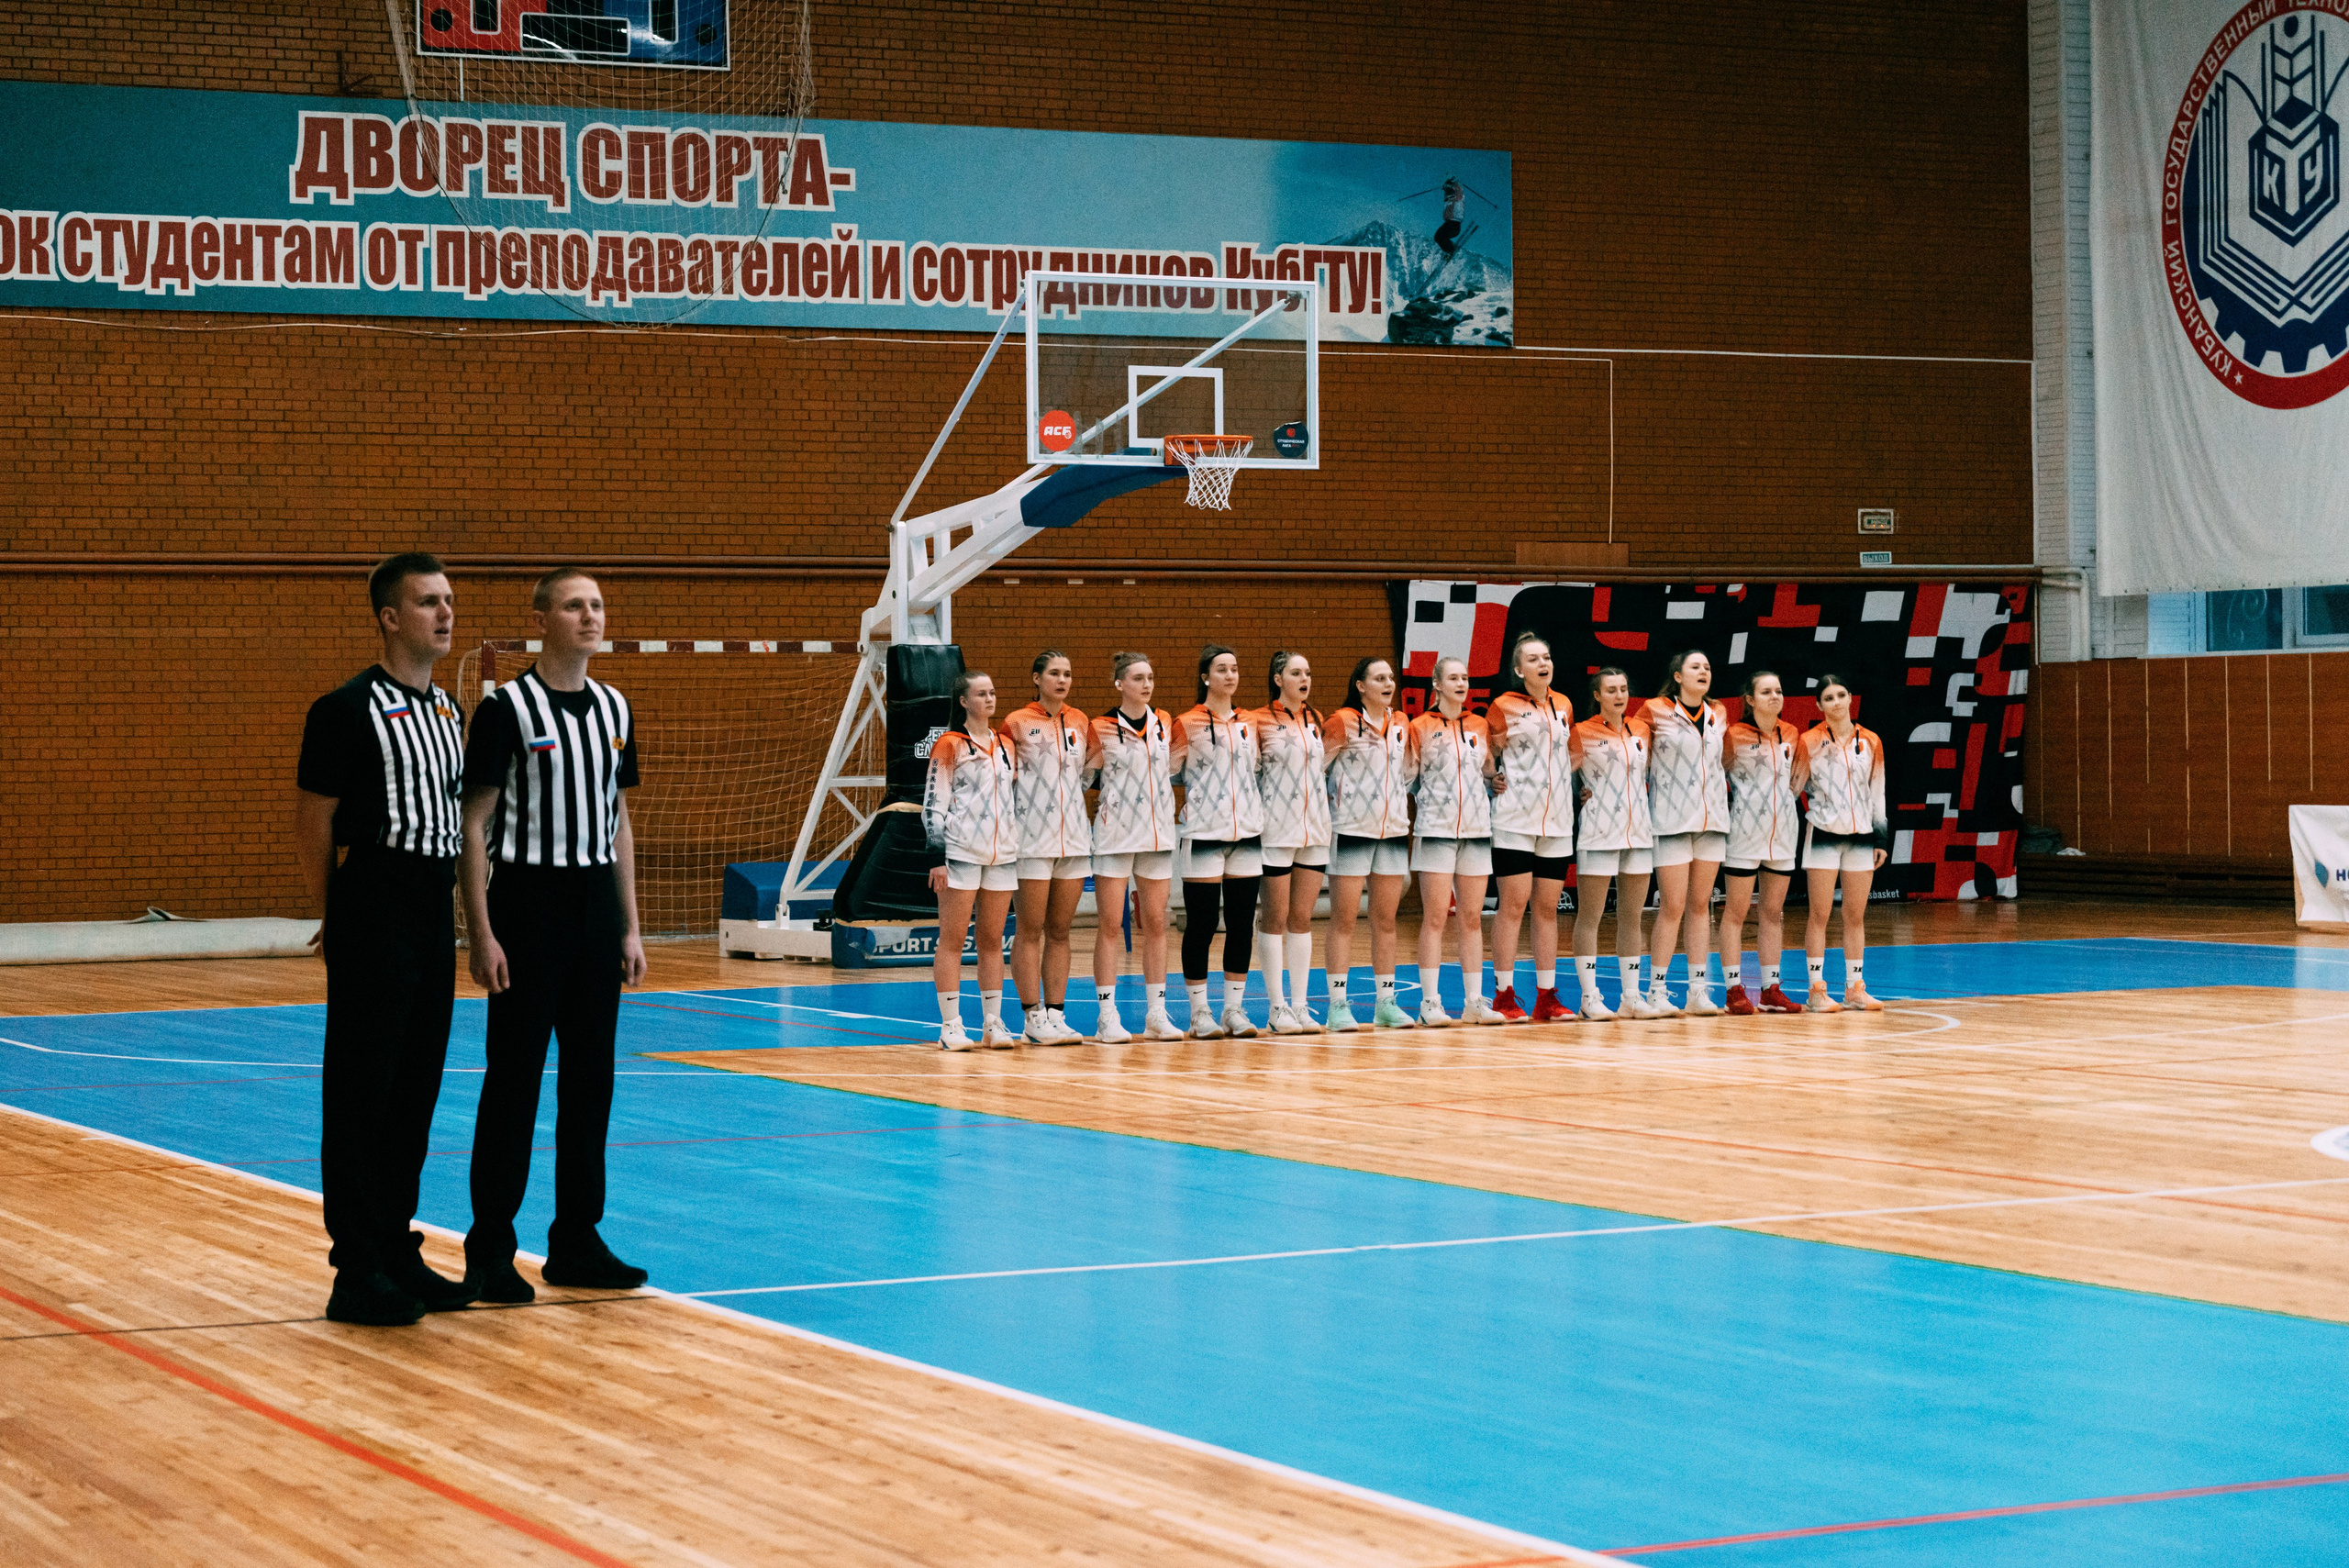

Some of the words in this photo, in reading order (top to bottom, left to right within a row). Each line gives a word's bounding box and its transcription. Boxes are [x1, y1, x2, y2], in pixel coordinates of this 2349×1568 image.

[2164, 0, 2277, 226] ГОСУДАРСТВЕННЫЙ
[295, 116, 566, 209] ДВОРЕЦ
[61, 214, 350, 291] студентам
[373, 227, 428, 287] от
[438, 226, 860, 303] преподавателей
[871, 245, 901, 301] и
[1224, 245, 1383, 317] КубГТУ!
[2164, 239, 2233, 377] КУБАНСКИЙ
[1863, 554, 1888, 562] ВЫХОД
[1868, 889, 1899, 899] sbasket
